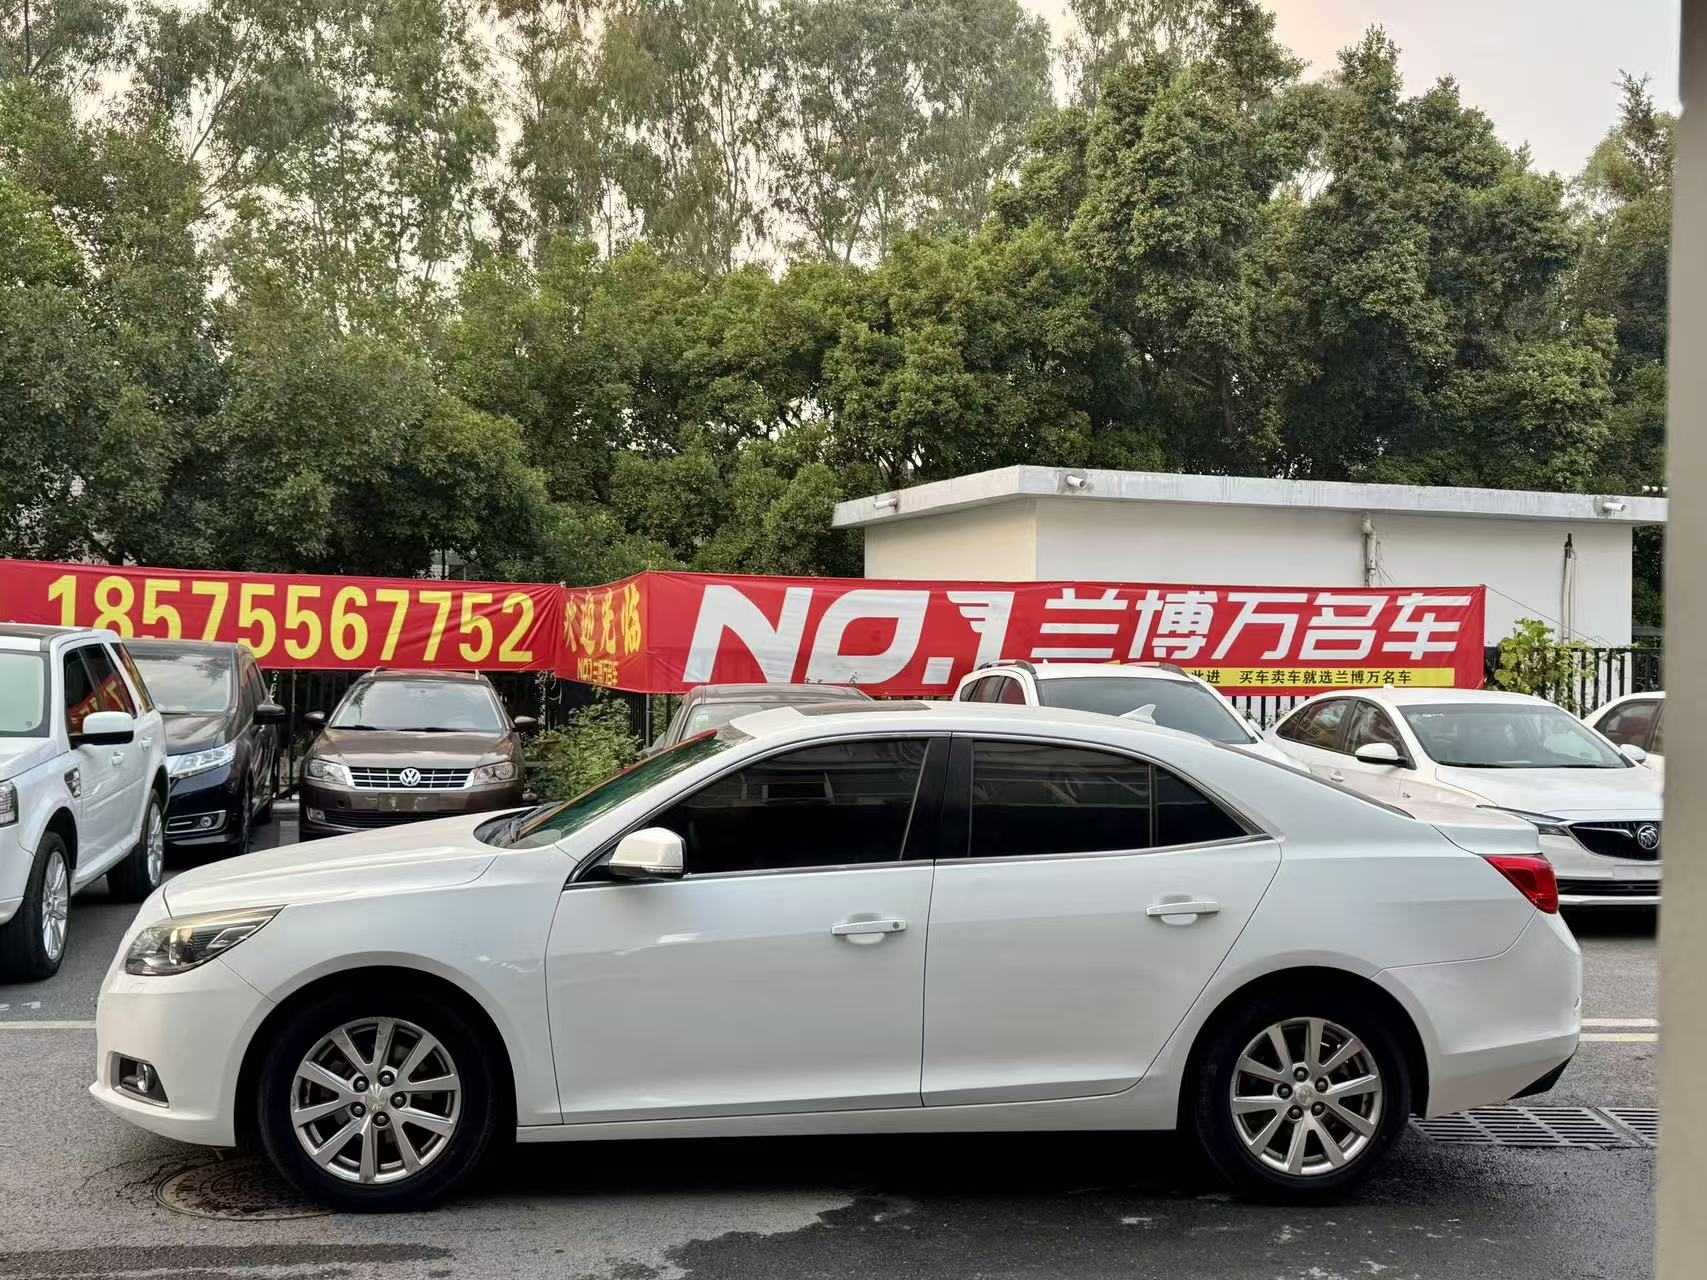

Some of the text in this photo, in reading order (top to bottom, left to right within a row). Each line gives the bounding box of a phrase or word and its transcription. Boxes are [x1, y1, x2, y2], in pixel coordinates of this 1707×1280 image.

[48, 574, 535, 663] 18575567752
[683, 584, 1472, 685] NO.1 兰博万名车
[1239, 670, 1412, 685] 买车卖车就选兰博万名车
